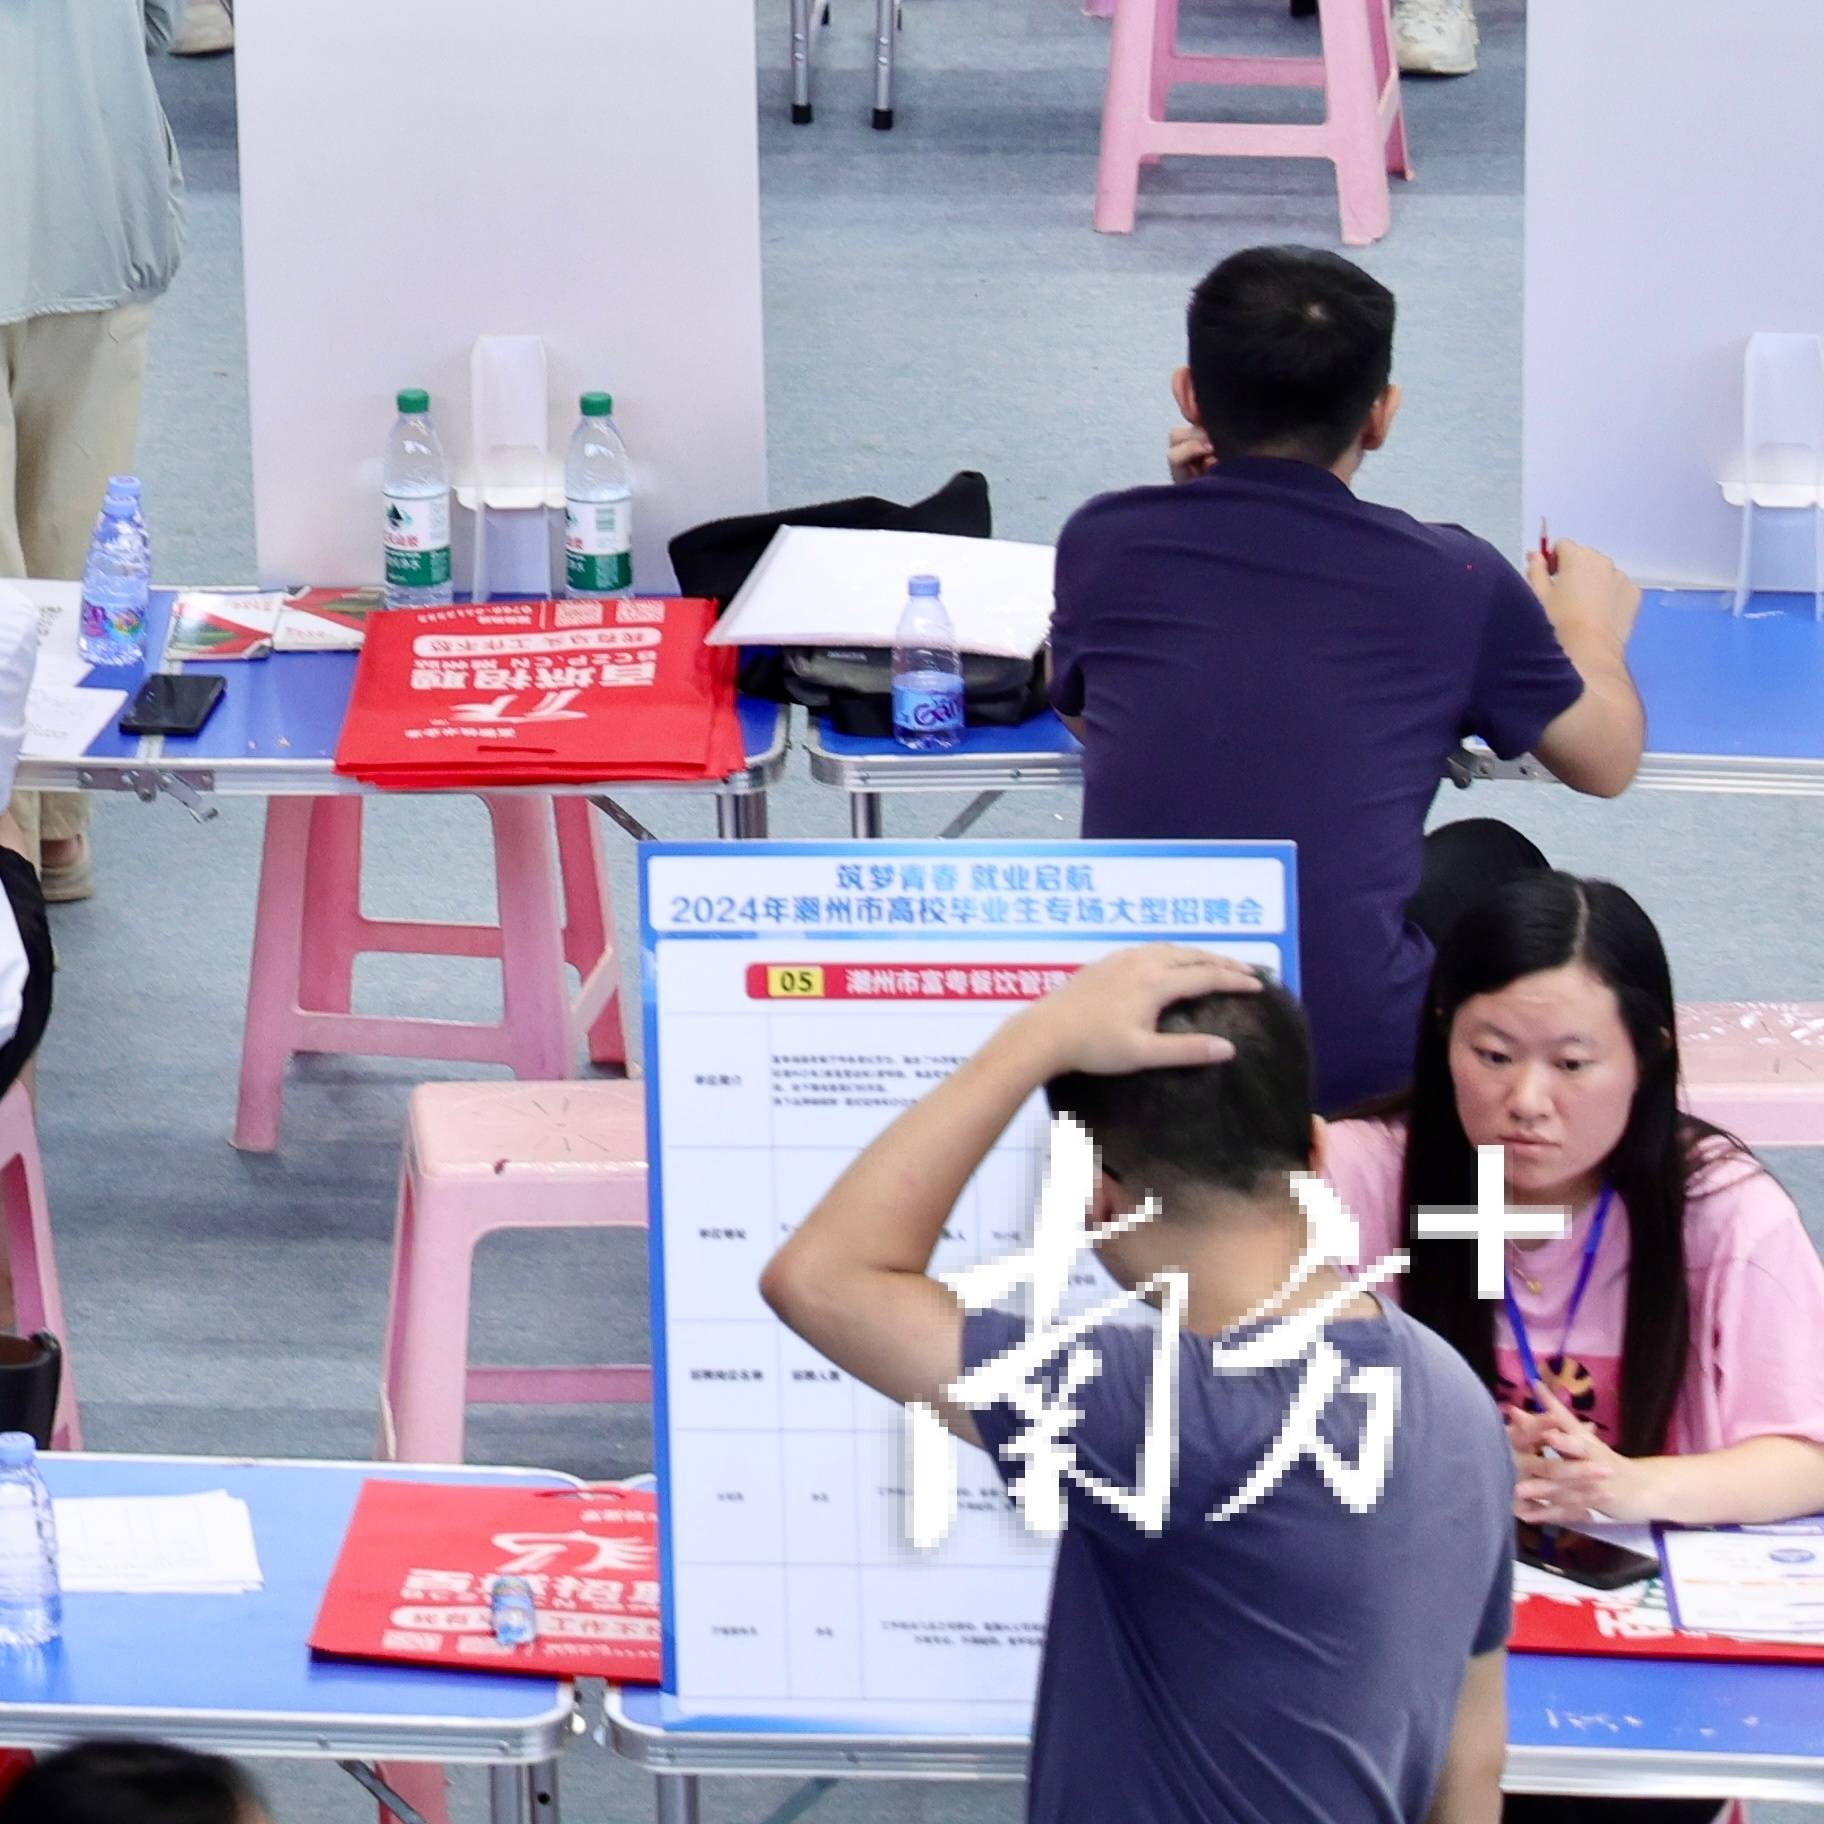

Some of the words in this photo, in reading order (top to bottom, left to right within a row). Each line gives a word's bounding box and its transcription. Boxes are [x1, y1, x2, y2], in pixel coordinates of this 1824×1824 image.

[410, 661, 657, 691] 百城招聘
[835, 863, 959, 893] 筑梦青春
[970, 863, 1096, 893] 就业启航
[670, 894, 1265, 927] 2024年潮州市高校毕业生专场大型招聘会
[780, 971, 814, 993] 05
